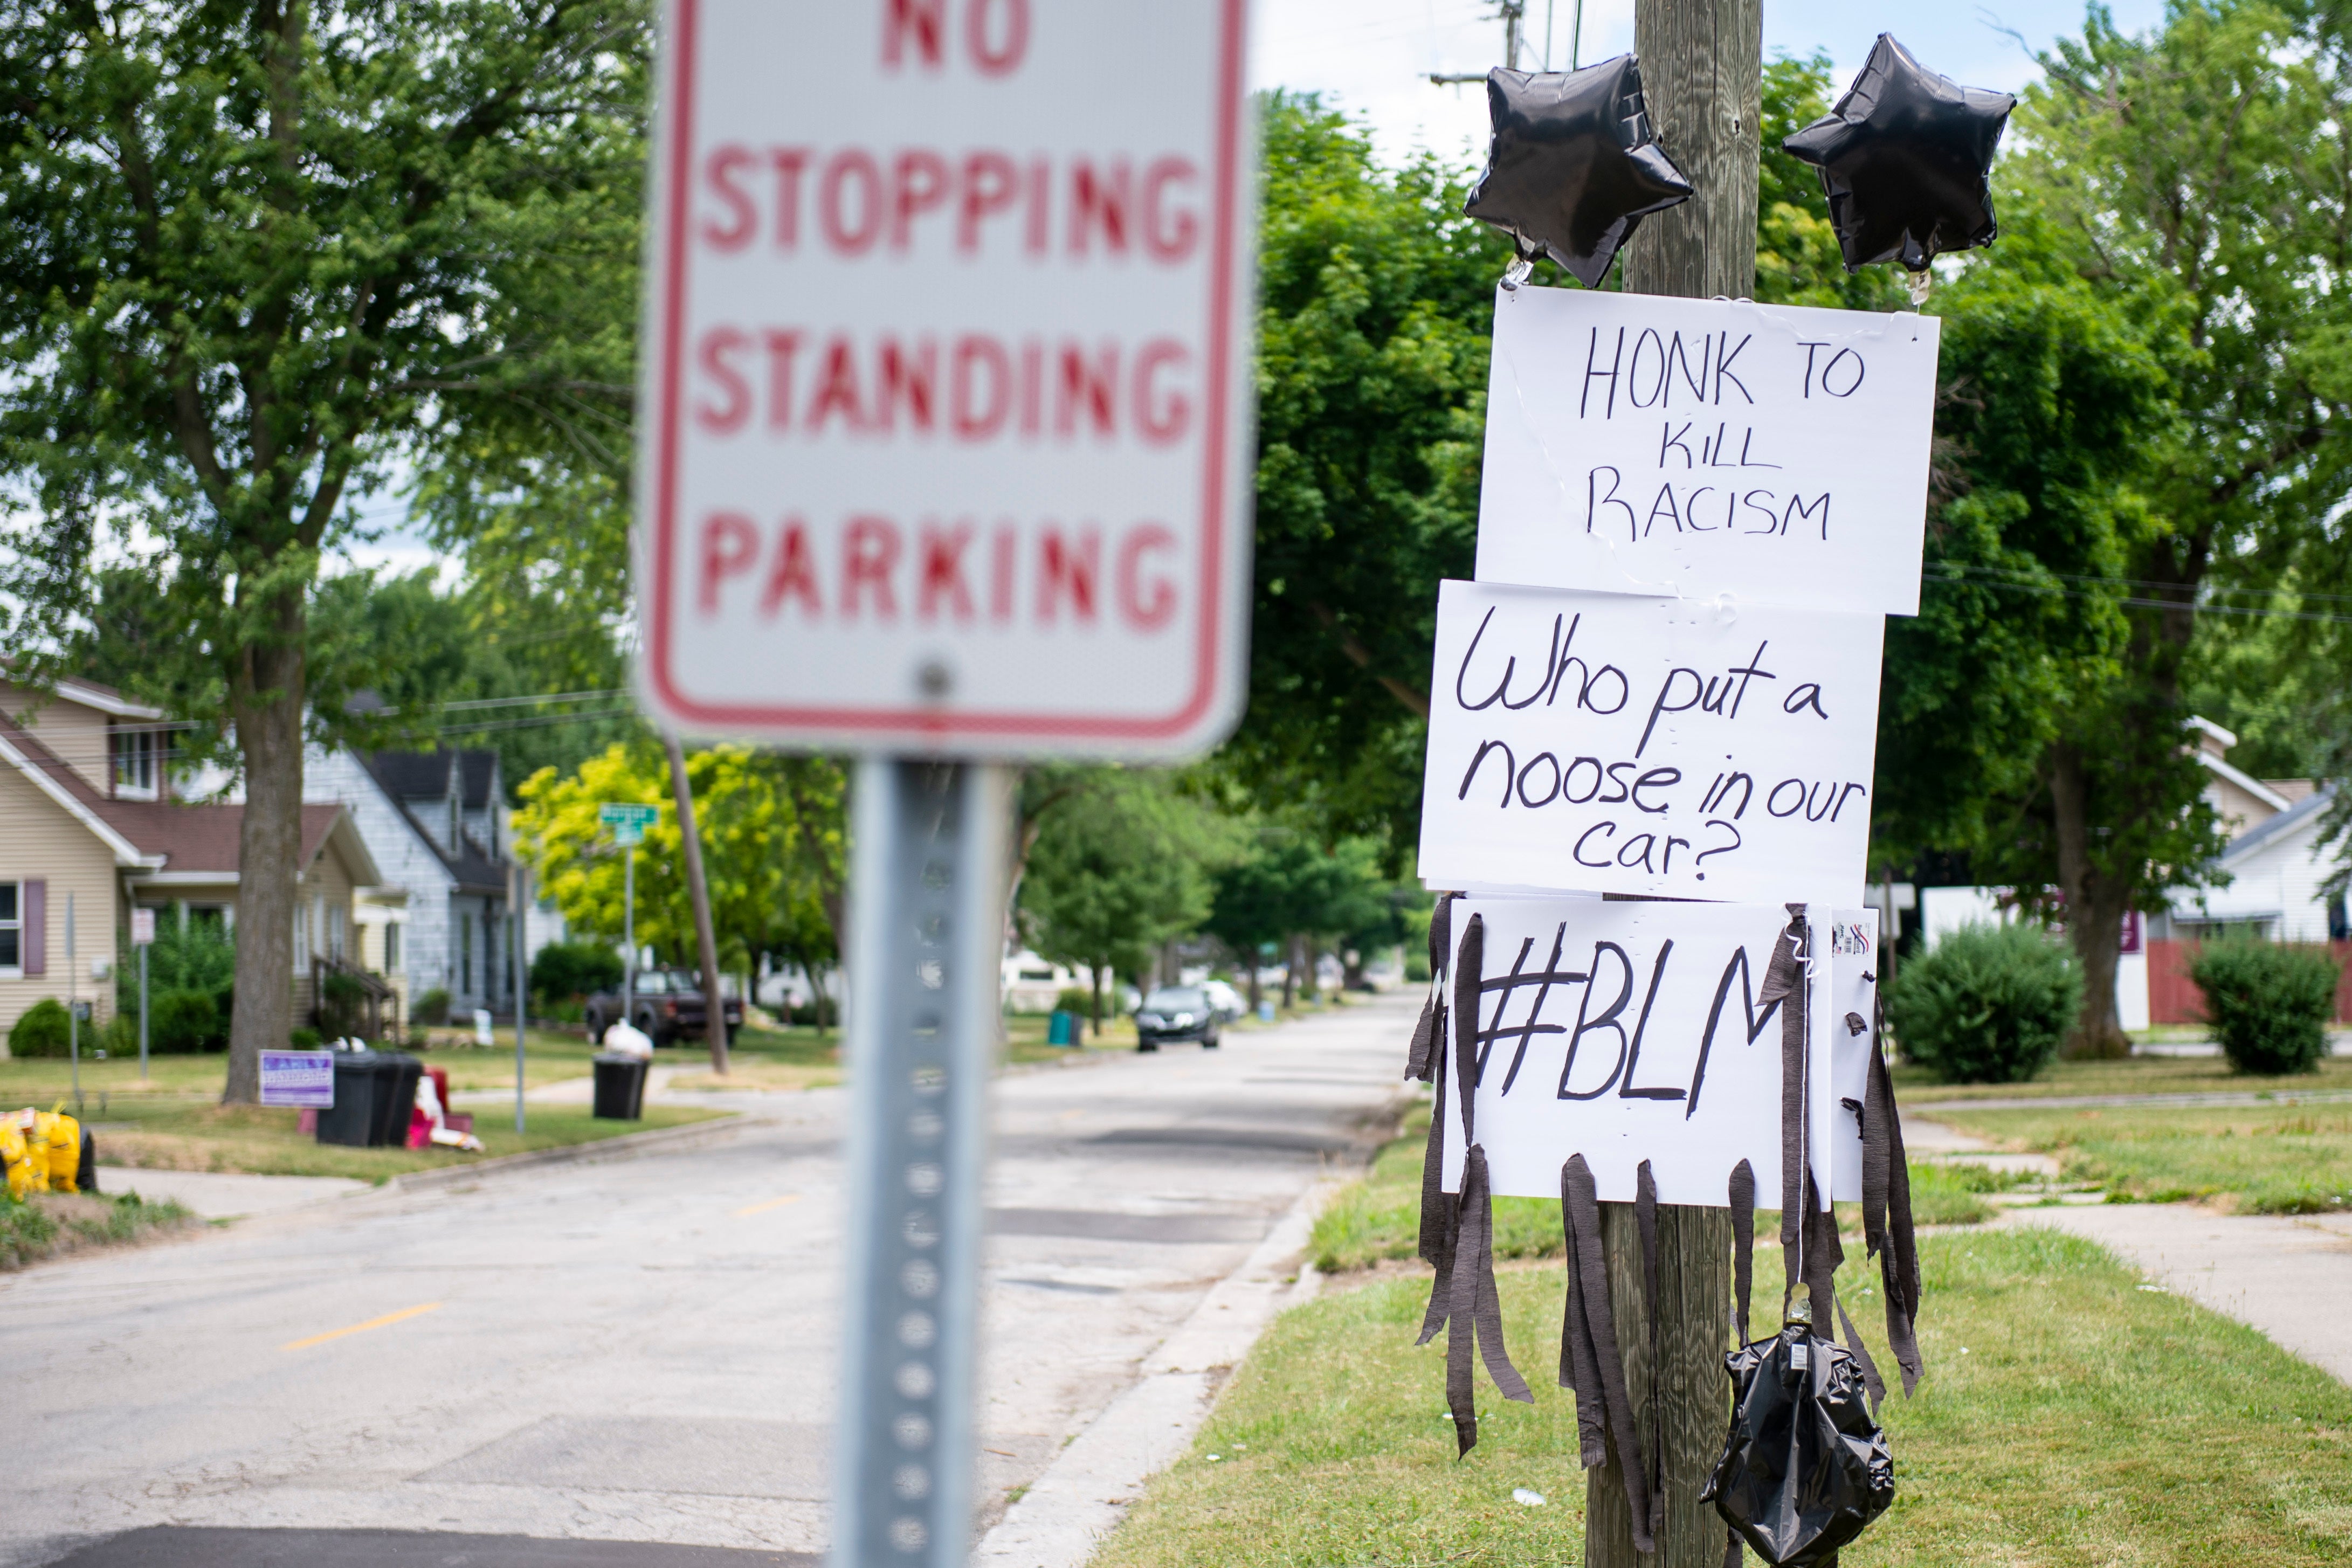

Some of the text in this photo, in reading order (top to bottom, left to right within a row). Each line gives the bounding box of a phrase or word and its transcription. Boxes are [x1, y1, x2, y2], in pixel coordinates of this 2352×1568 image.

[882, 0, 1029, 78] NO
[700, 143, 1201, 267] STOPPING
[695, 326, 1193, 448] STANDING
[1581, 326, 1865, 419] HONK TO
[1660, 422, 1782, 469] KILL
[1587, 466, 1830, 542] RACISM
[698, 511, 1178, 634] PARKING
[1456, 606, 1829, 759] Who put a
[1458, 739, 1866, 823] noose in our
[1573, 820, 1741, 881] car?
[1476, 921, 1784, 1121] #BLM
